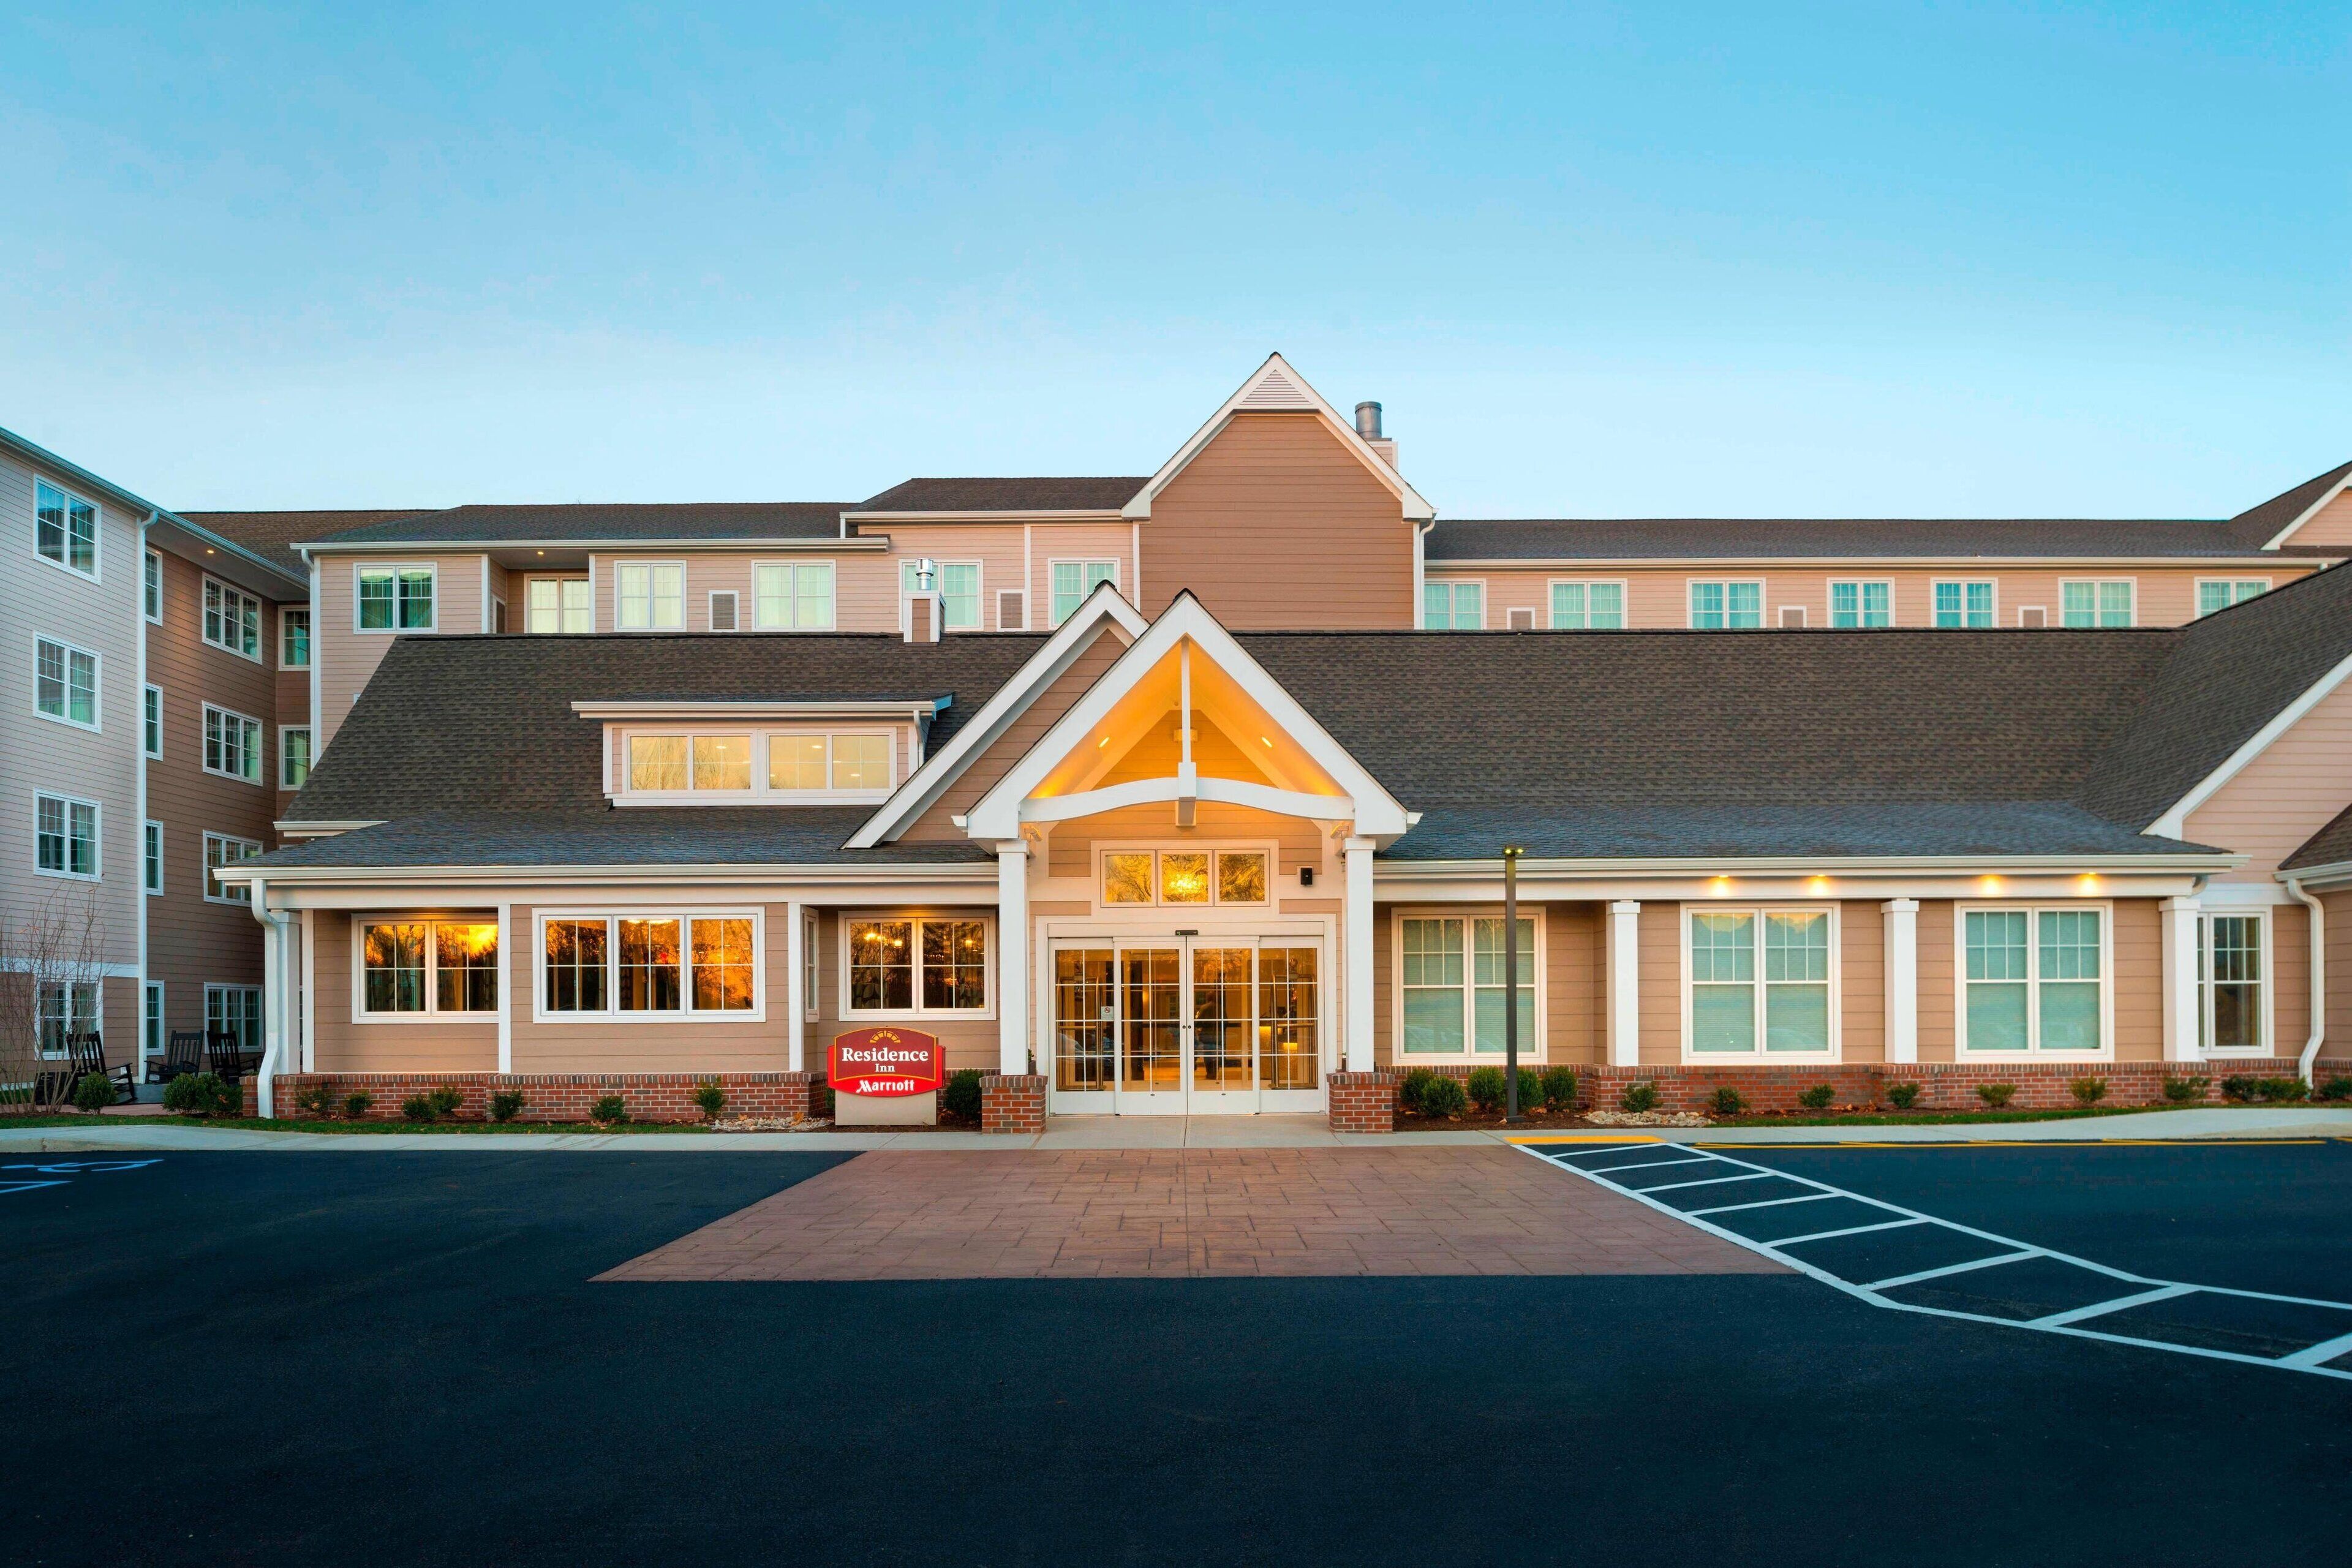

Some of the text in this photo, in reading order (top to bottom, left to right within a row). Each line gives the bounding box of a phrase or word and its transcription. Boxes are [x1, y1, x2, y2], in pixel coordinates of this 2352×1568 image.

[842, 1047, 929, 1061] Residence
[875, 1063, 895, 1072] Inn
[856, 1079, 915, 1093] Marriott
